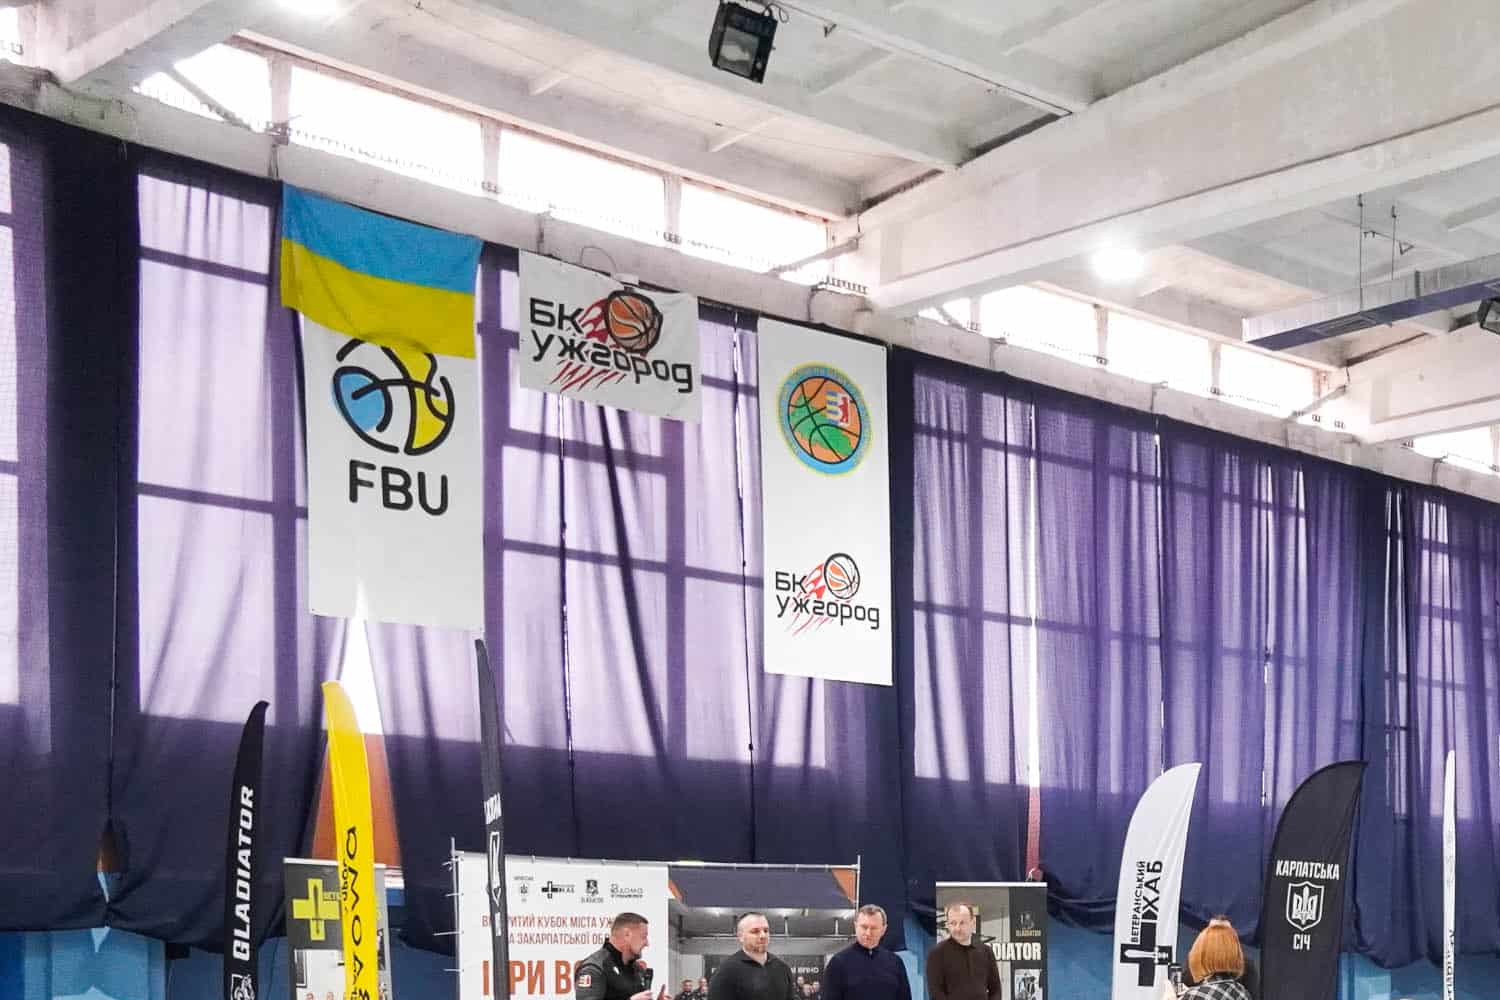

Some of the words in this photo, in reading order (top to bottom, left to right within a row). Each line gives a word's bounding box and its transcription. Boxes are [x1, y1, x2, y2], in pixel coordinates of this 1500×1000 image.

[530, 297, 584, 334] БК
[349, 459, 449, 516] FBU
[776, 571, 807, 594] БК
[233, 784, 254, 962] GLADIATOR
[1276, 859, 1340, 880] КАРПАТСЬКА
[1143, 860, 1162, 913] ХАБ
[1131, 860, 1145, 943] ВЕТЕРАНСЬКИЙ
[538, 914, 566, 928] КУБОК
[569, 914, 597, 928] МІСТА
[517, 932, 590, 946] ЗАКАРПАТСЬКОЇ
[990, 942, 1042, 961] DIATOR
[1293, 933, 1311, 951] СІЧ
[482, 960, 545, 995] ІРИ
